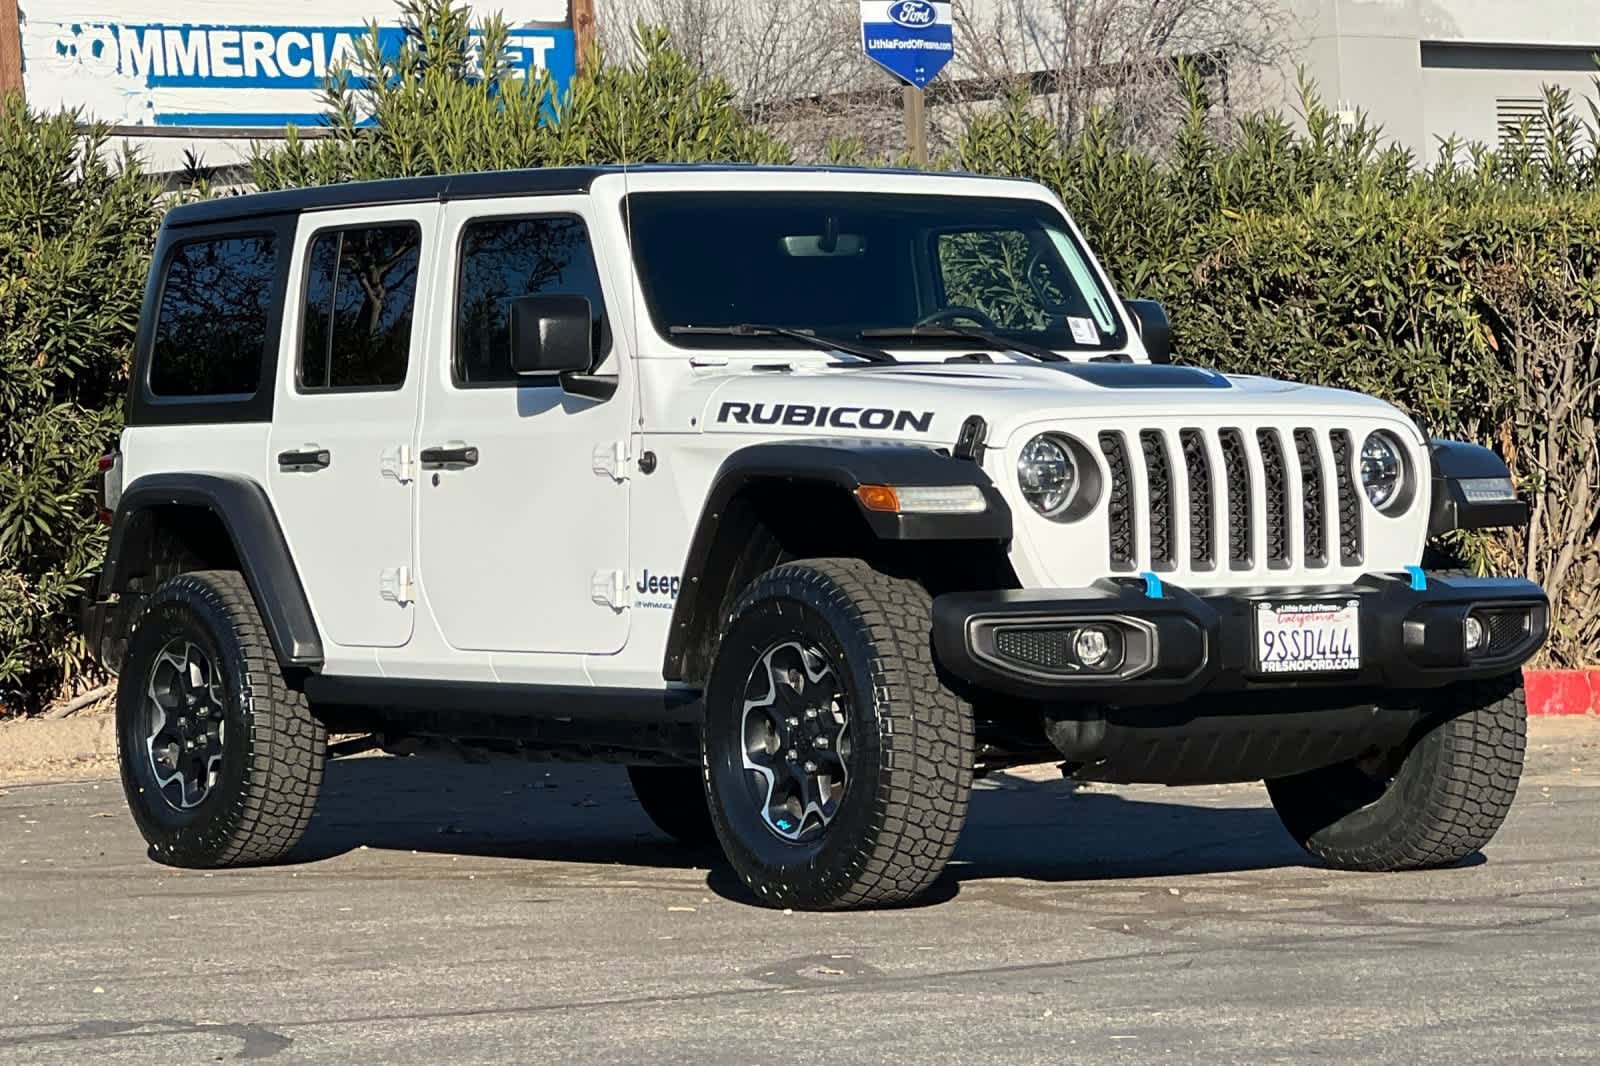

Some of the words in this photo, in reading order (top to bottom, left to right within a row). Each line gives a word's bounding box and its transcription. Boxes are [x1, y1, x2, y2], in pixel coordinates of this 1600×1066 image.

[900, 1, 930, 22] Ford
[717, 402, 935, 432] RUBICON
[636, 568, 680, 599] Jeep
[1277, 611, 1337, 627] California
[1263, 628, 1353, 661] 9SSD444
[1261, 659, 1359, 672] FRESNOFORD.COM
